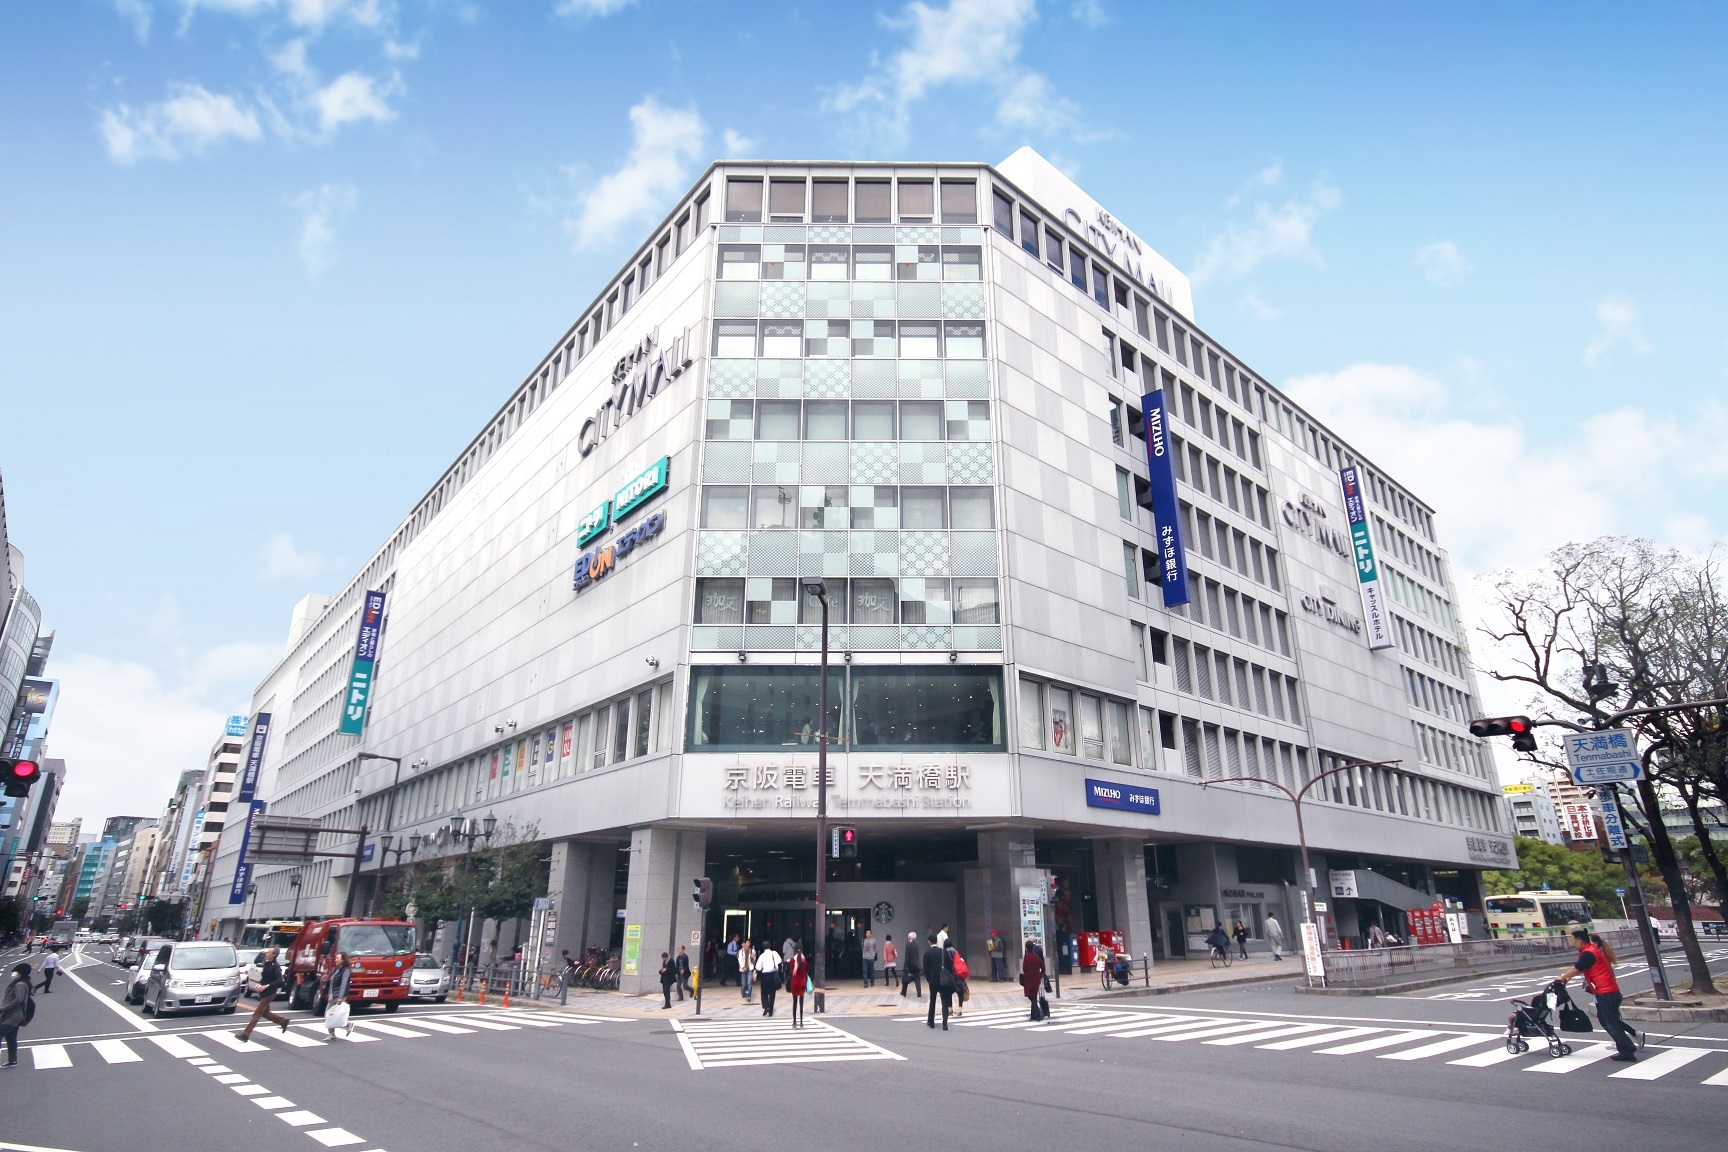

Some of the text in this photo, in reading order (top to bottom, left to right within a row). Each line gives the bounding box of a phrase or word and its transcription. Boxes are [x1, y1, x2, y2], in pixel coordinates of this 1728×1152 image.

[1063, 208, 1117, 260] CITY
[1095, 207, 1142, 256] KEIHAN
[578, 326, 693, 457] CITY MALL
[1149, 406, 1165, 457] MIZUHO
[615, 465, 660, 511] NITORI
[1345, 469, 1356, 495] EDION
[577, 506, 605, 541] ニトリ
[1347, 496, 1358, 523] エディオン
[1282, 500, 1349, 558] CITY MALL
[1161, 525, 1178, 583] みずほ銀行
[1353, 530, 1373, 574] ニトリ
[366, 596, 382, 624] EDION
[1300, 592, 1323, 617] CITY
[1366, 587, 1384, 640] キャッスルホテル
[358, 626, 371, 657] エディオン
[346, 672, 368, 721] ニトリ
[1571, 733, 1628, 753] 天満橋
[1573, 750, 1632, 763] Tenmabashi
[723, 762, 972, 790] 京阪電車 天満橋駅
[1586, 765, 1628, 776] 土佐堀通
[723, 794, 774, 809] Keihan
[922, 794, 972, 809] Station
[1093, 785, 1121, 799] MIZUHO
[1129, 793, 1155, 806] みずほ銀行
[1566, 804, 1588, 814] 日本
[1598, 788, 1625, 847] 歩車分離式
